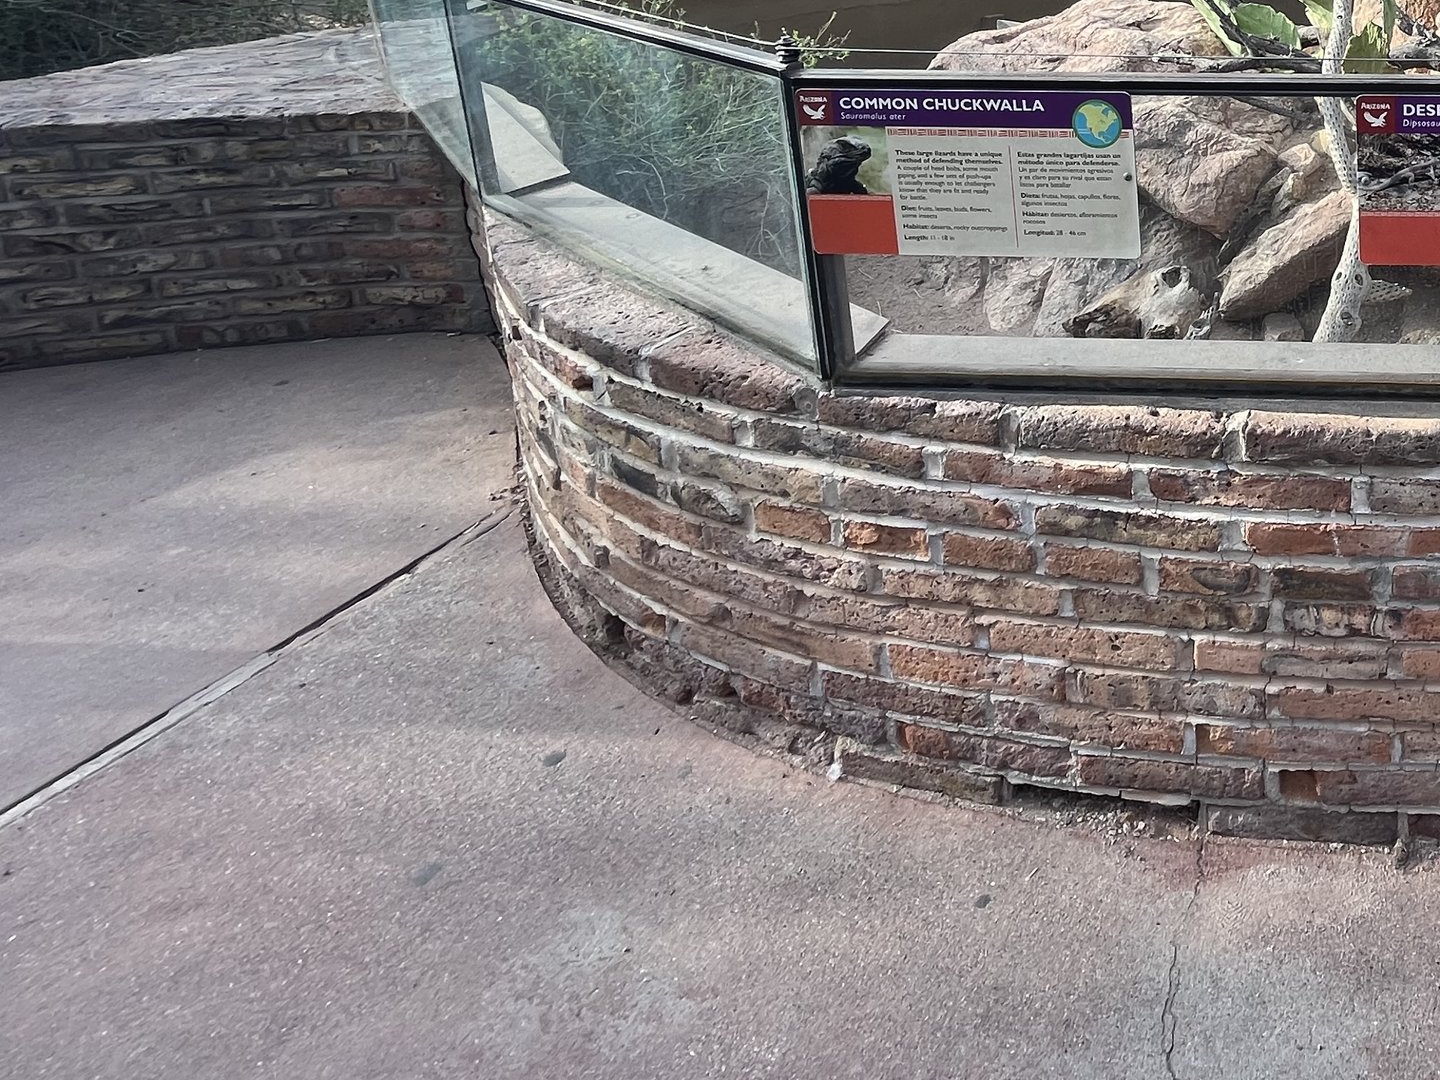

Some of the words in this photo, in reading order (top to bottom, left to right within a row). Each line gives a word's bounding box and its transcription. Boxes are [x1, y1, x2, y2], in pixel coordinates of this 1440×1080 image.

[839, 97, 918, 110] COMMON
[923, 98, 1045, 112] CHUCKWALLA
[840, 112, 887, 120] Sauromalus
